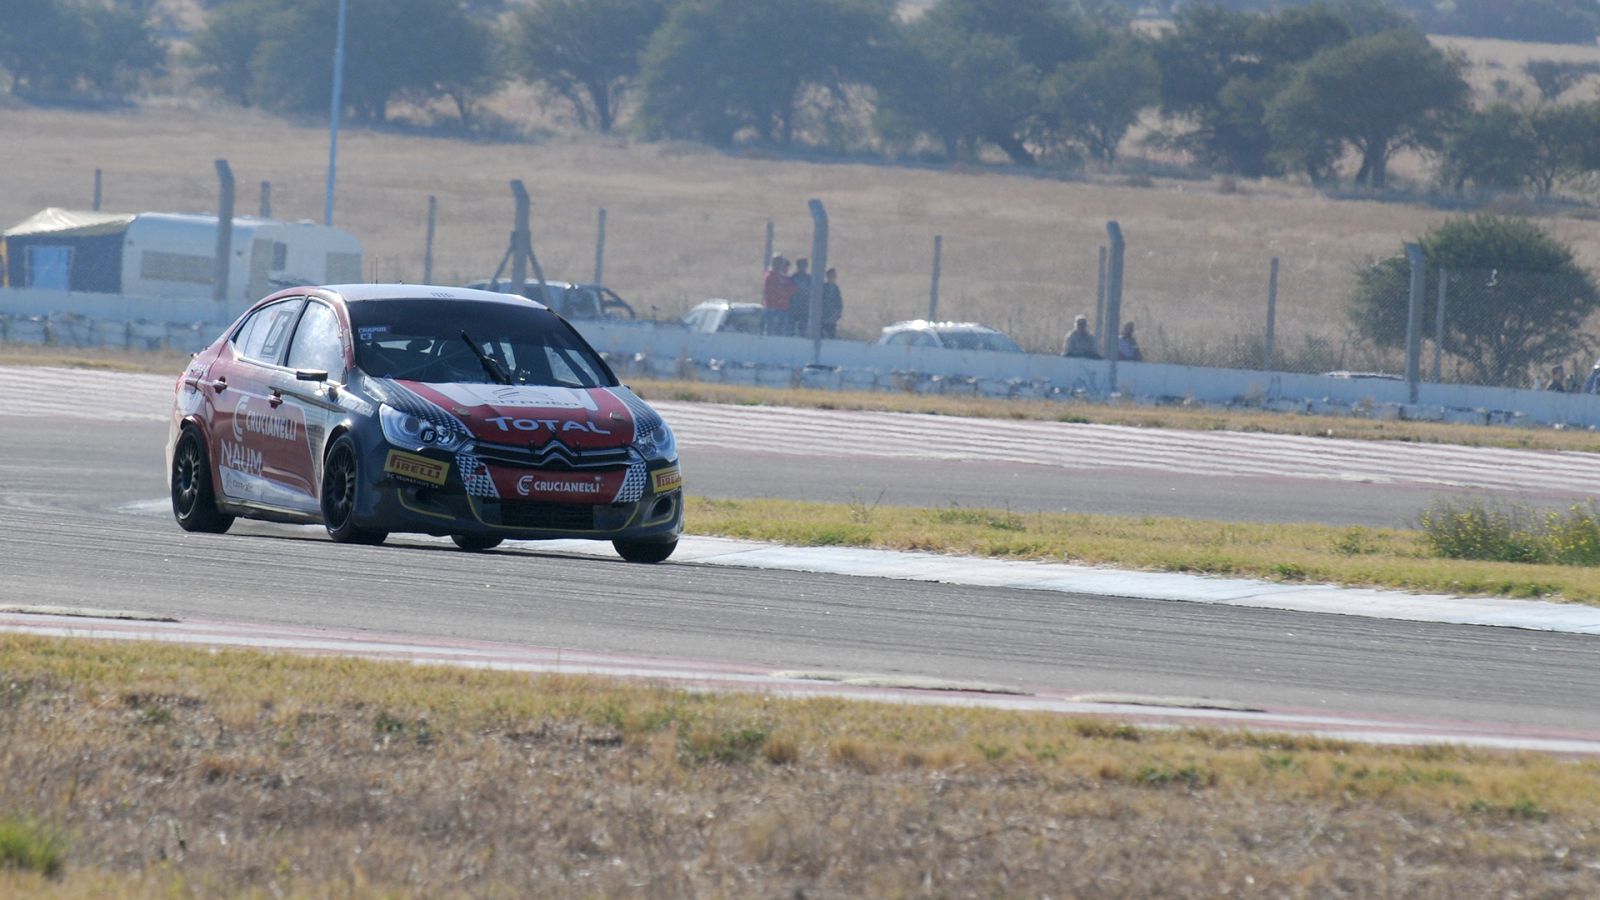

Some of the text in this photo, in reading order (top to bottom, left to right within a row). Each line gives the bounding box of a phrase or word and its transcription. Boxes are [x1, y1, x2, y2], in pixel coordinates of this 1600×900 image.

[246, 410, 297, 441] CRUCIANELLI
[485, 416, 611, 434] TOTAL
[221, 438, 262, 477] NAUM
[390, 454, 442, 479] PIRELLI
[534, 481, 600, 493] CRUCIANELLI
